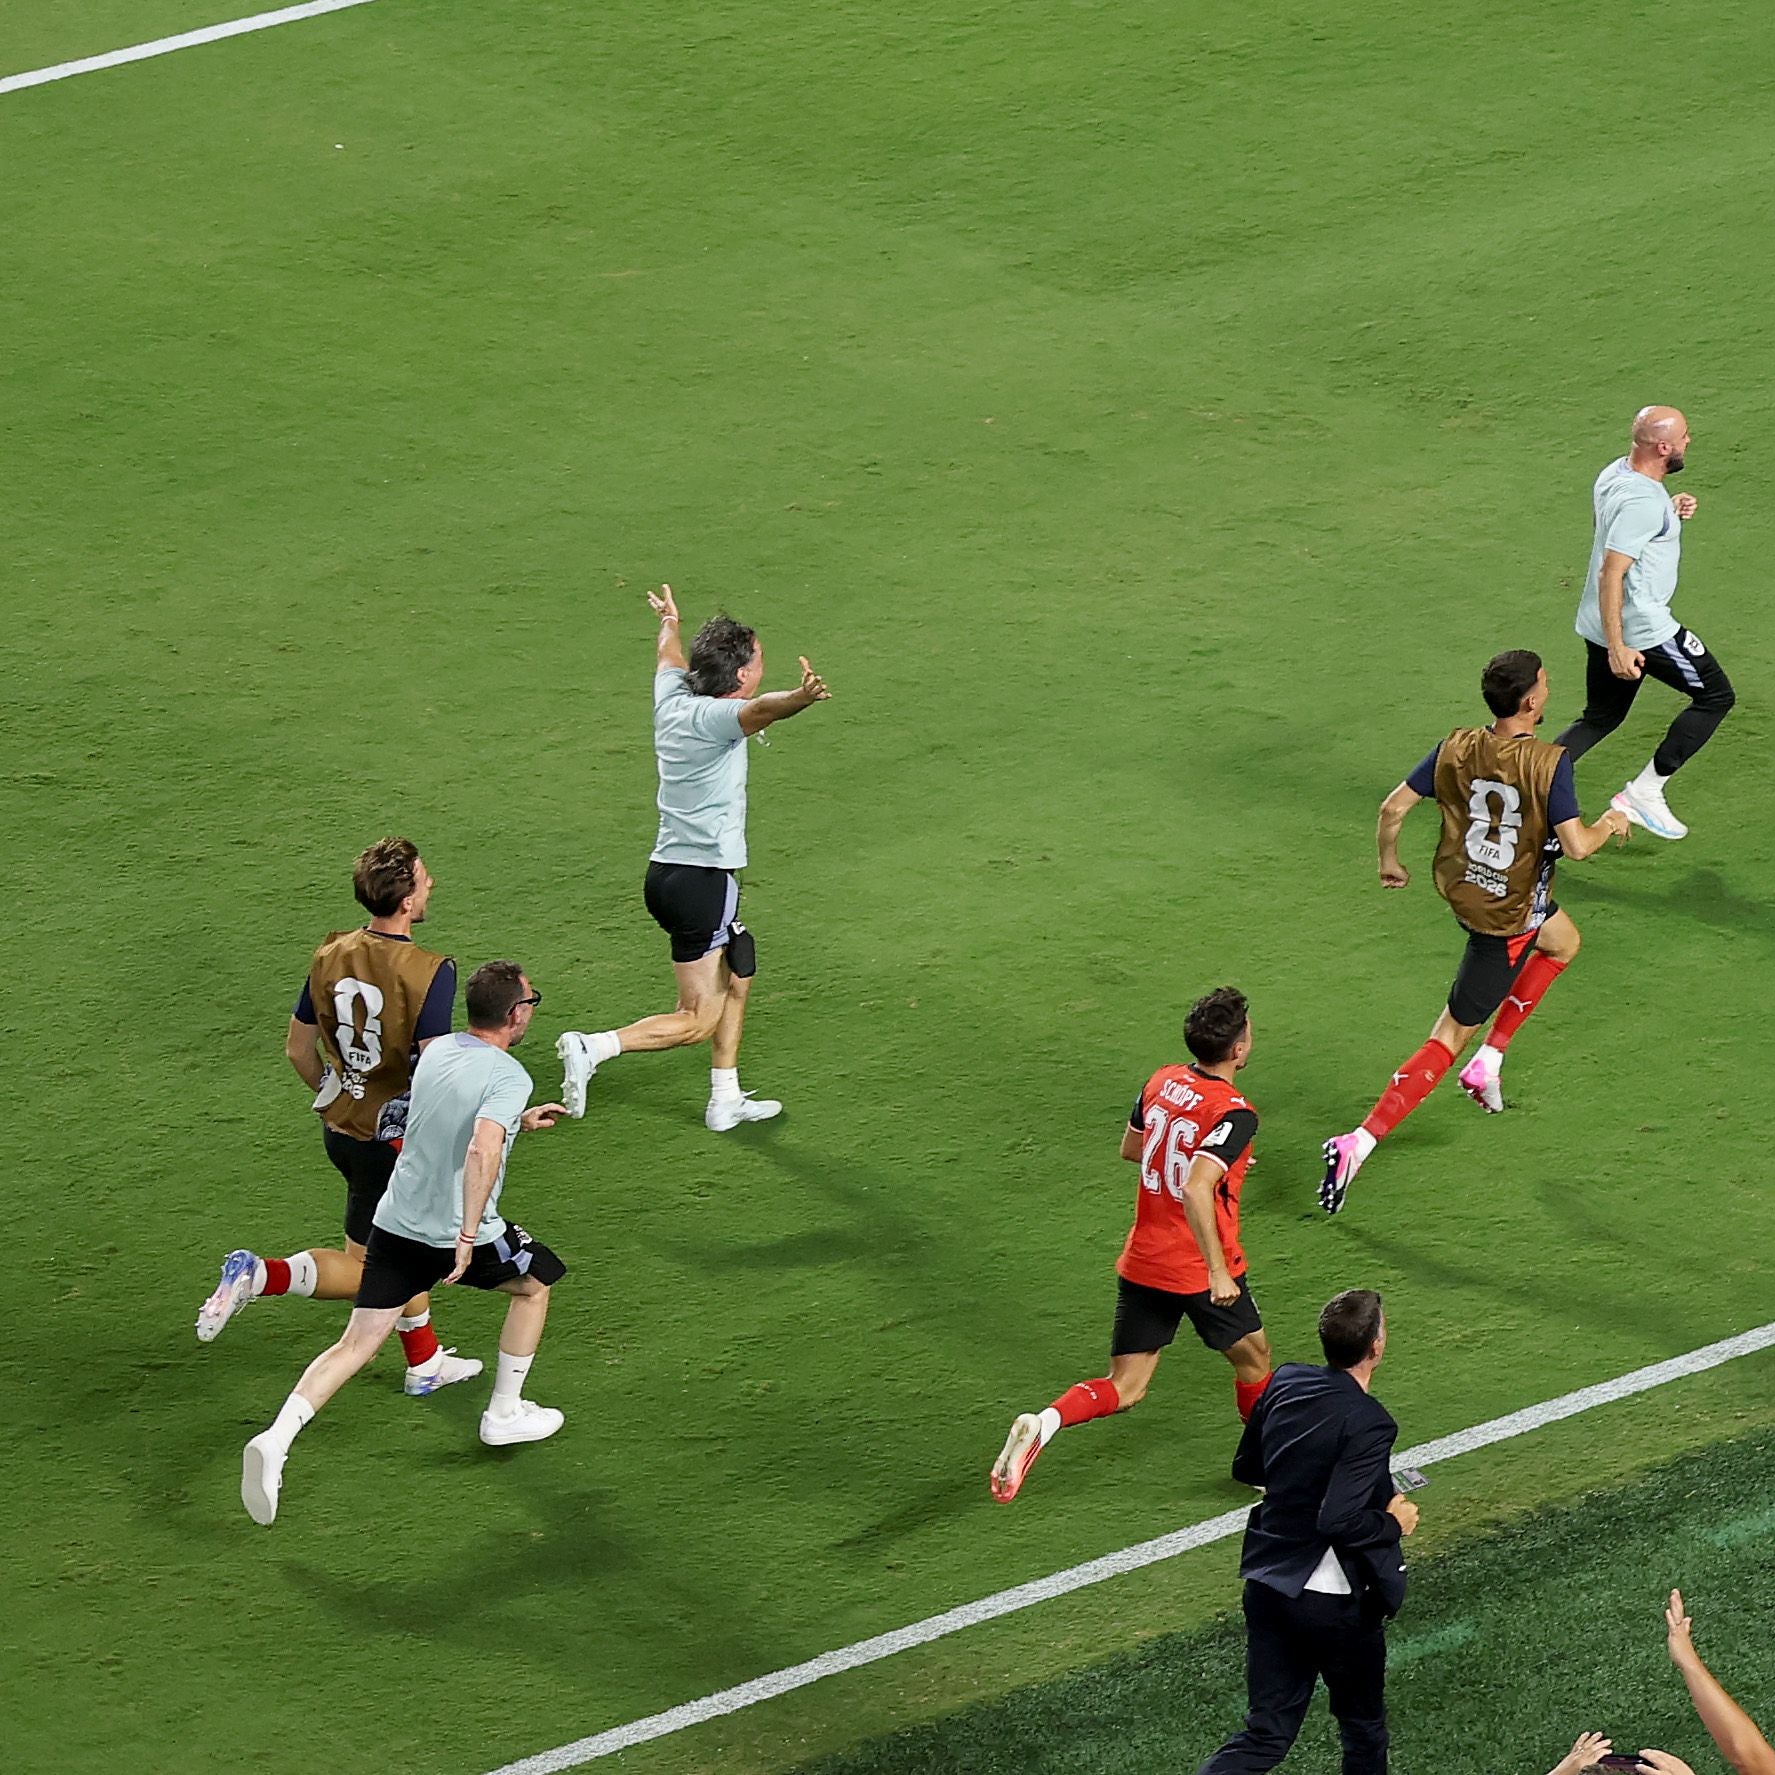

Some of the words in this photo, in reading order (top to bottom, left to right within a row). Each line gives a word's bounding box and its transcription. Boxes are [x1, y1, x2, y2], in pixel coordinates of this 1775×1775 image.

[1479, 845, 1500, 860] FIFA
[1464, 871, 1508, 898] 2026
[348, 1050, 372, 1065] FIFA
[1141, 1103, 1199, 1203] 26
